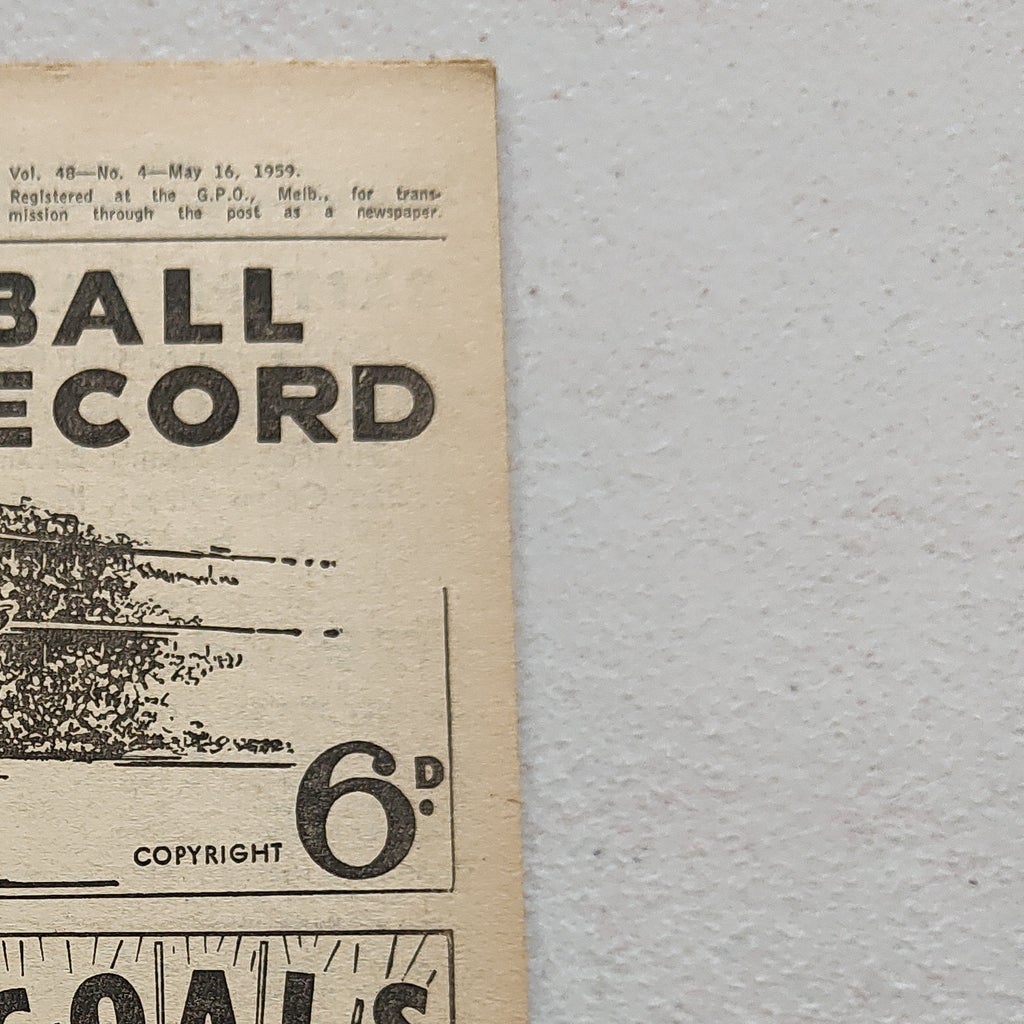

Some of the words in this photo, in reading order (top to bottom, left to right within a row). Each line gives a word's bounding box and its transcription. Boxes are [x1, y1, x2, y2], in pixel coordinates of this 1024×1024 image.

[9, 166, 41, 181] Vol.
[215, 164, 240, 181] 16,
[254, 164, 301, 179] 1959.
[10, 189, 93, 206] Registered
[114, 190, 131, 203] at
[152, 187, 176, 203] the
[197, 187, 256, 204] G.P.O.,
[278, 187, 328, 202] Melb.,
[351, 186, 374, 201] for
[396, 186, 441, 201] trans-
[9, 207, 68, 222] mission
[93, 206, 154, 222] through
[178, 206, 202, 220] the
[227, 205, 262, 222] post
[284, 207, 301, 218] as
[325, 206, 333, 218] a
[357, 206, 442, 221] newspaper.
[134, 842, 282, 866] COPYRIGHT
